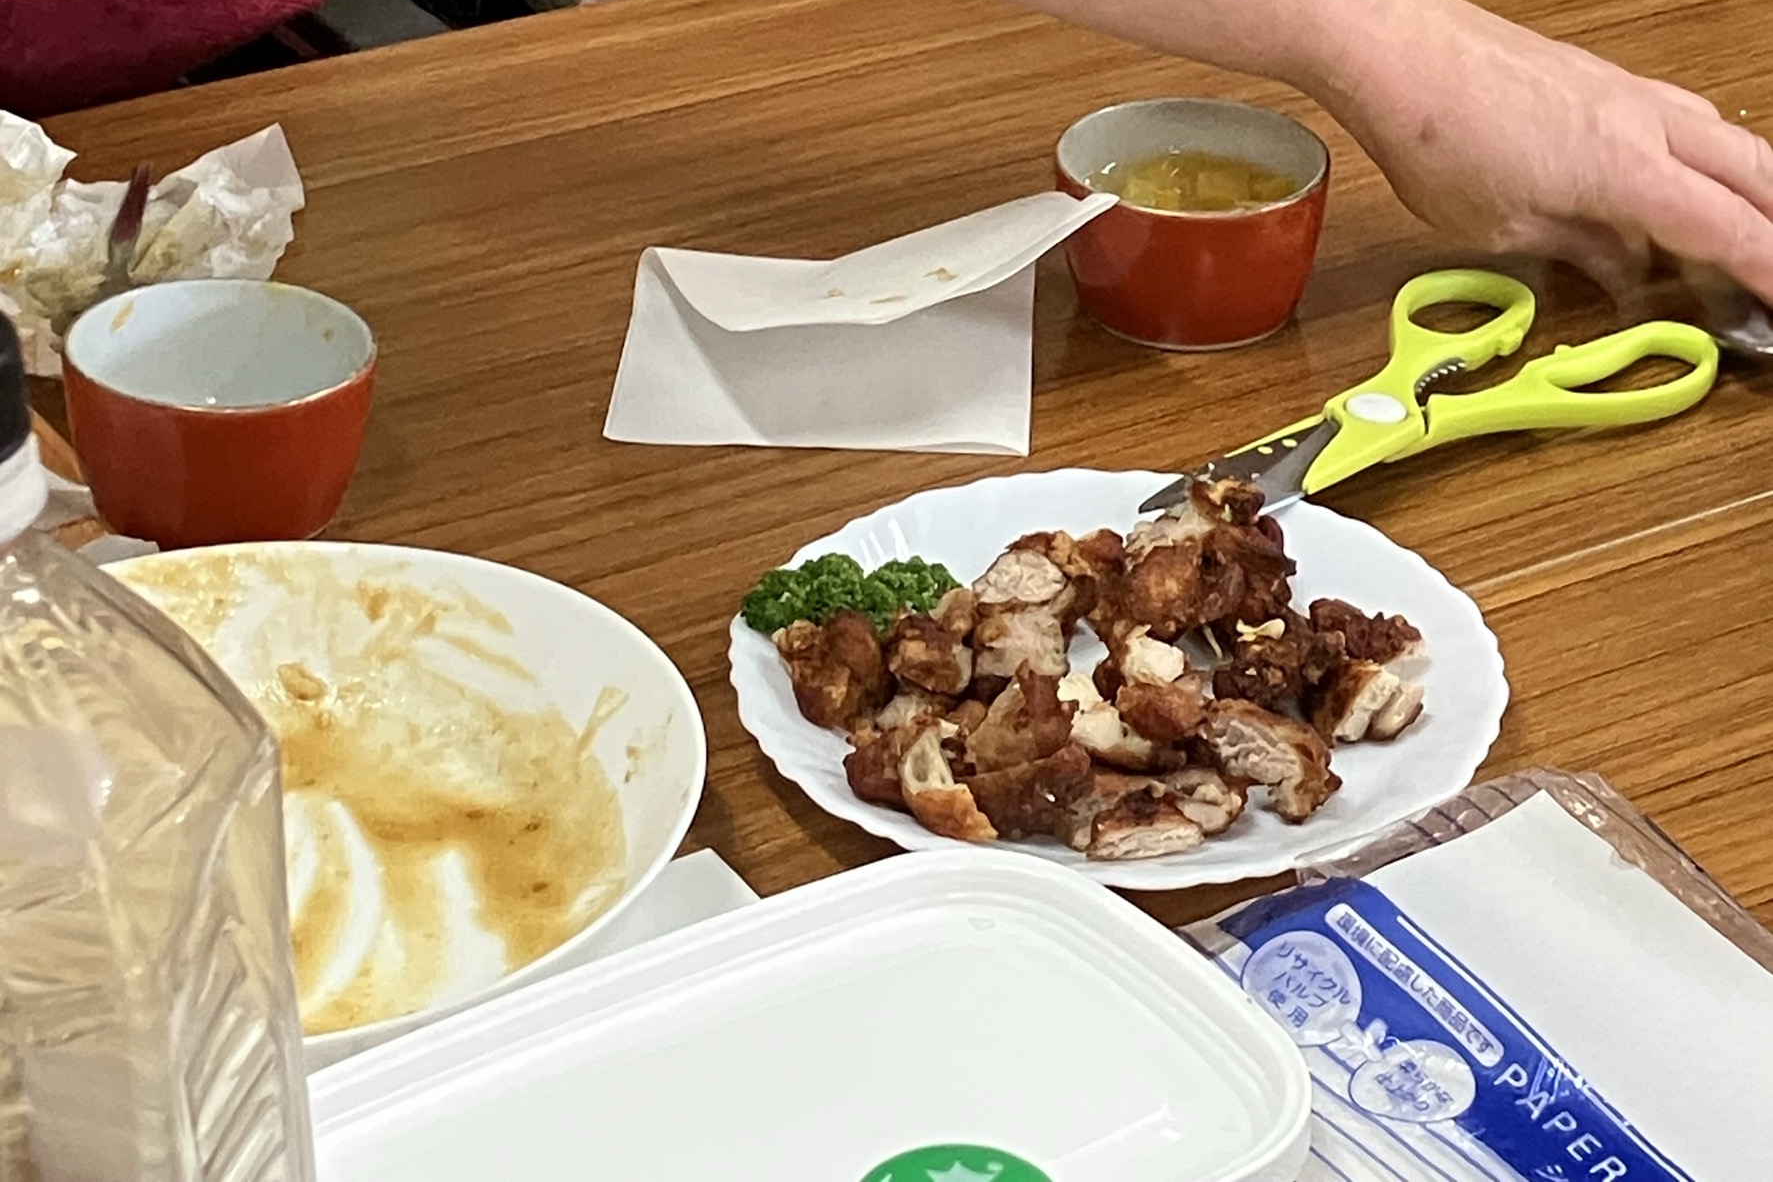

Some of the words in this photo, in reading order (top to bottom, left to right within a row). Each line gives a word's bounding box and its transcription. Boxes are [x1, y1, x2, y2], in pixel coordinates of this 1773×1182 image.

[1267, 989, 1309, 1028] 使用
[1276, 942, 1351, 1005] リサイクル
[1336, 911, 1494, 1054] 環境に配慮した商品です
[1493, 1063, 1627, 1182] PAPER
